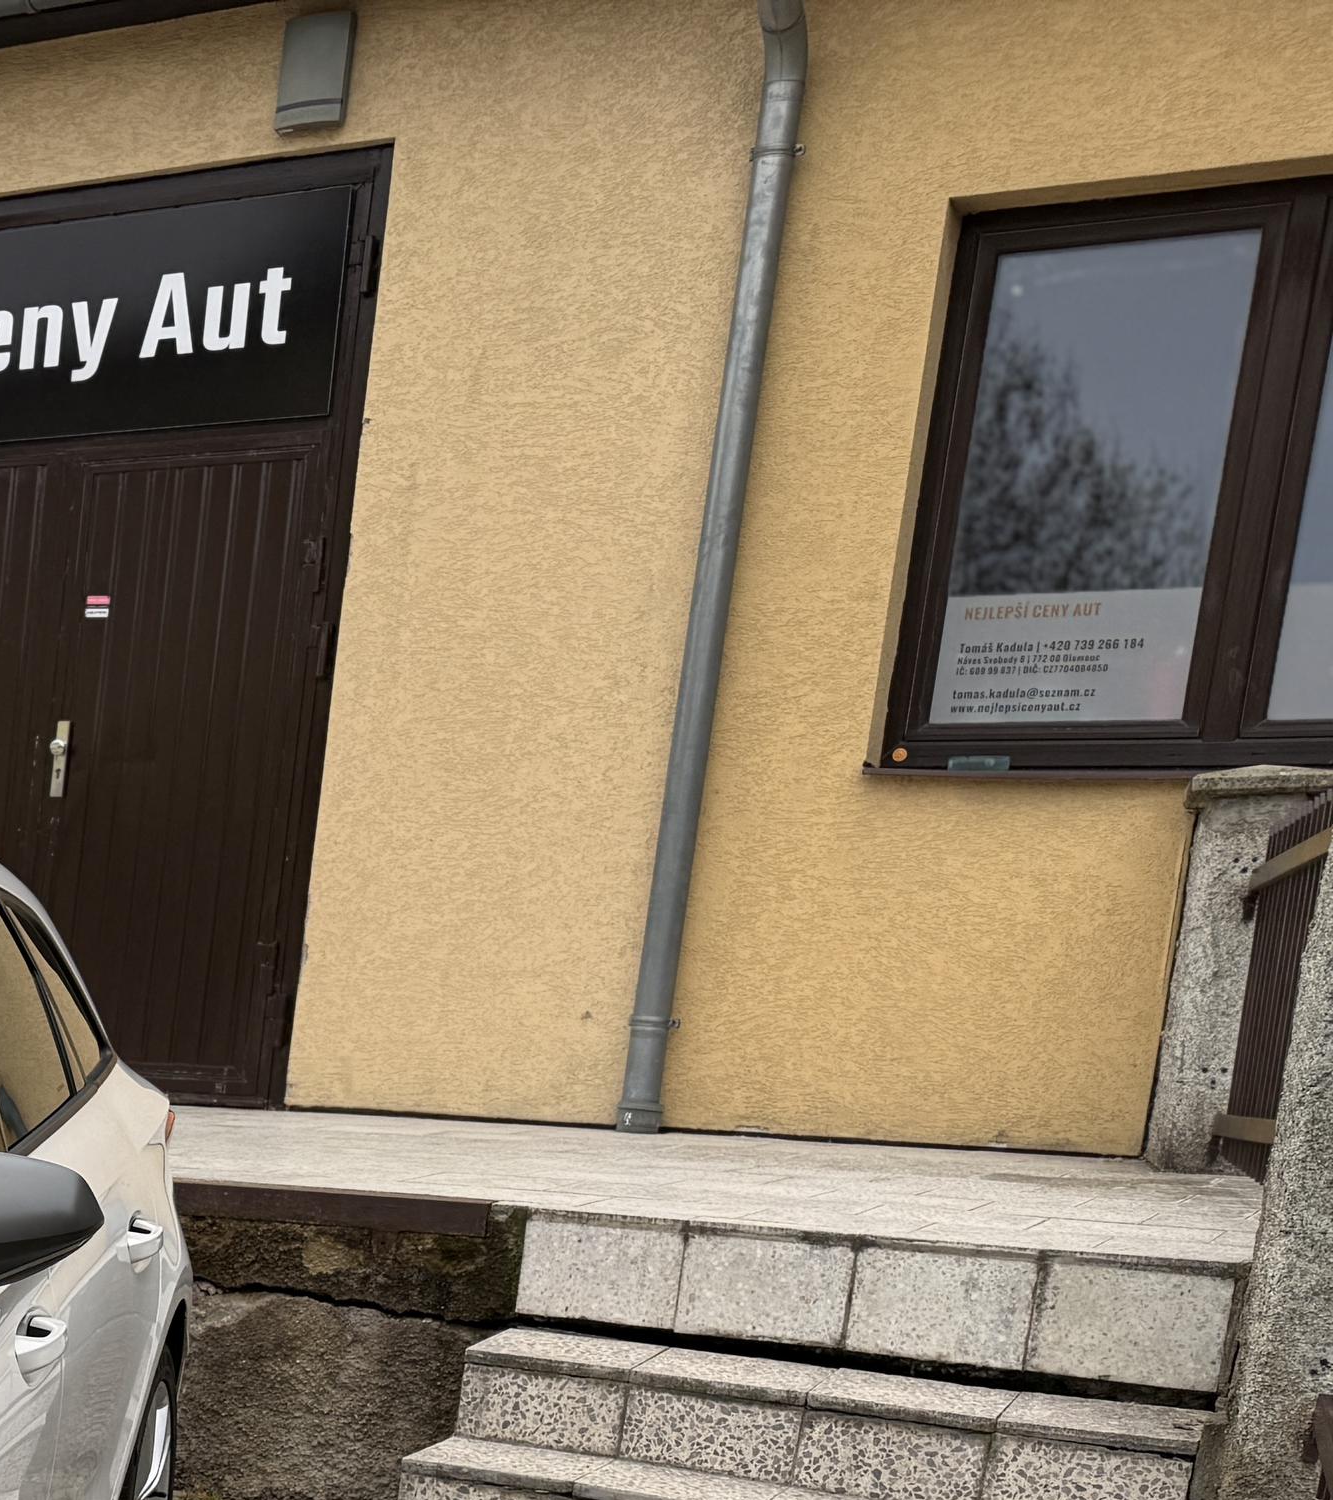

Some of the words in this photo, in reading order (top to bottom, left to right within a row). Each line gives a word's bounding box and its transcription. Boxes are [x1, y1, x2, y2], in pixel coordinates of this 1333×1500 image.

[139, 266, 294, 360] Aut
[965, 603, 1029, 621] NEJLEPŠÍ
[1032, 603, 1070, 618] CENY
[1073, 602, 1102, 617] AUT
[960, 642, 993, 654] Tomáš
[996, 641, 1034, 653] Kadula
[1074, 639, 1095, 651] 739
[1097, 638, 1121, 650] 266
[1124, 638, 1144, 650] 184
